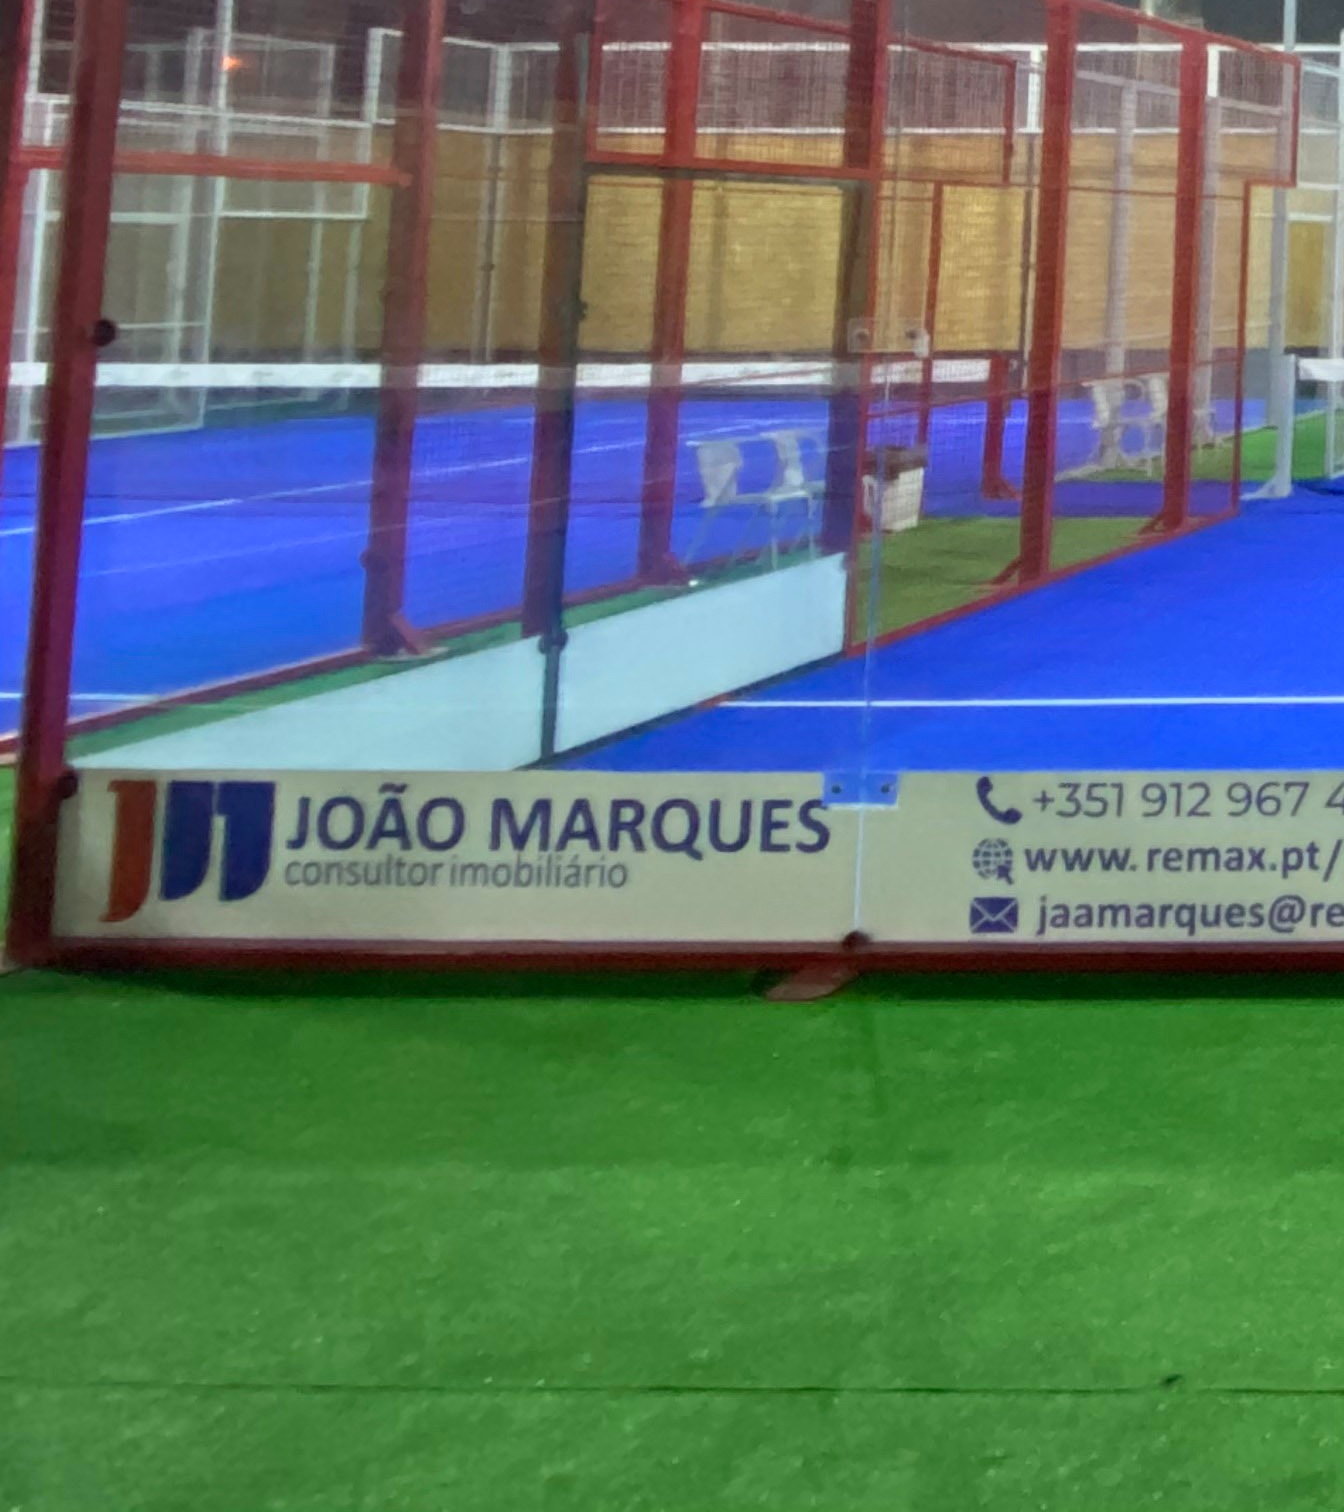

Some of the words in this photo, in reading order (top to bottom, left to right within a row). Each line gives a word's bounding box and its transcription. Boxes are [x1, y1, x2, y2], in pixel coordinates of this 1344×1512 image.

[1033, 781, 1124, 819] +351
[1141, 781, 1212, 818] 912
[1226, 781, 1311, 818] 967
[286, 782, 466, 852] JOÃO
[490, 797, 831, 861] MARQUES
[284, 854, 444, 889] consultor
[449, 853, 629, 889] imobiliário
